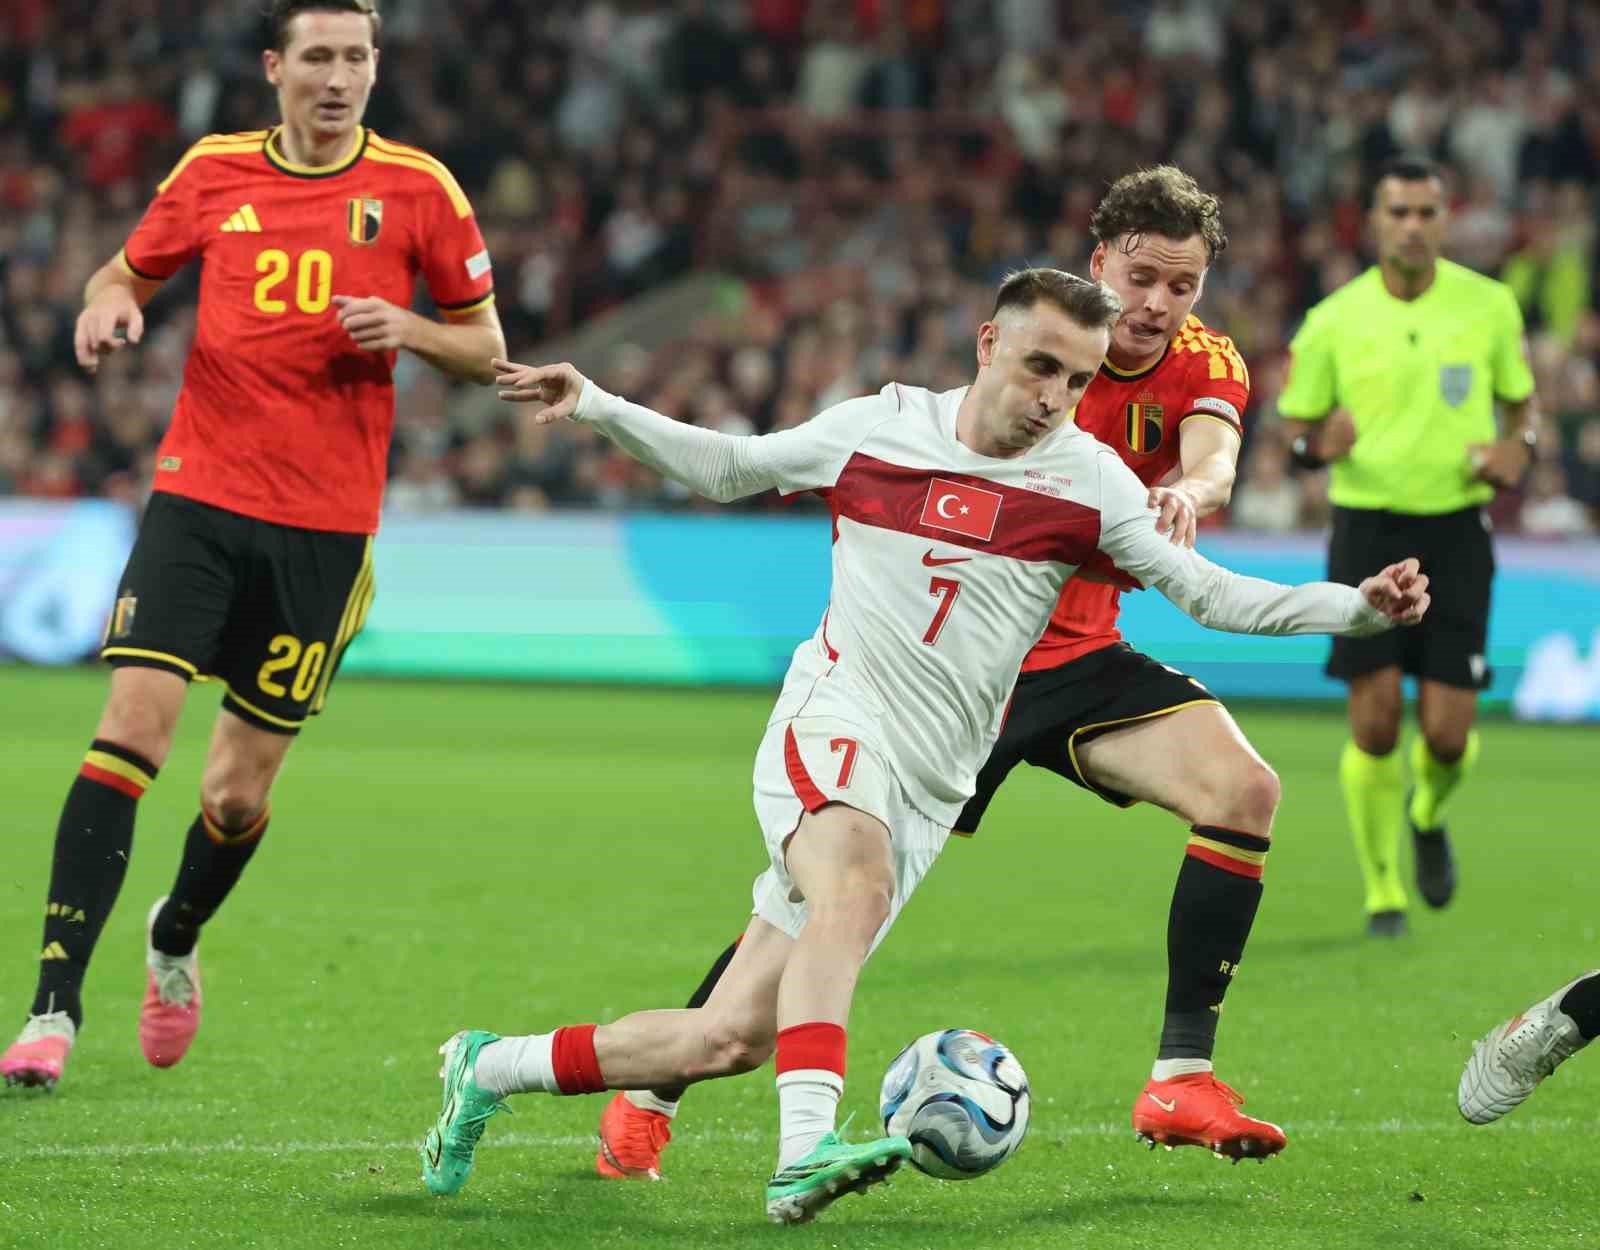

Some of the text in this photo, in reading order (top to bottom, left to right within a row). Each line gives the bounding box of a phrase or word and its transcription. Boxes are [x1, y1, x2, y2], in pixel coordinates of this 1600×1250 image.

[255, 249, 332, 313] 20
[922, 576, 960, 646] 7
[257, 634, 326, 701] 20
[830, 736, 859, 790] 7
